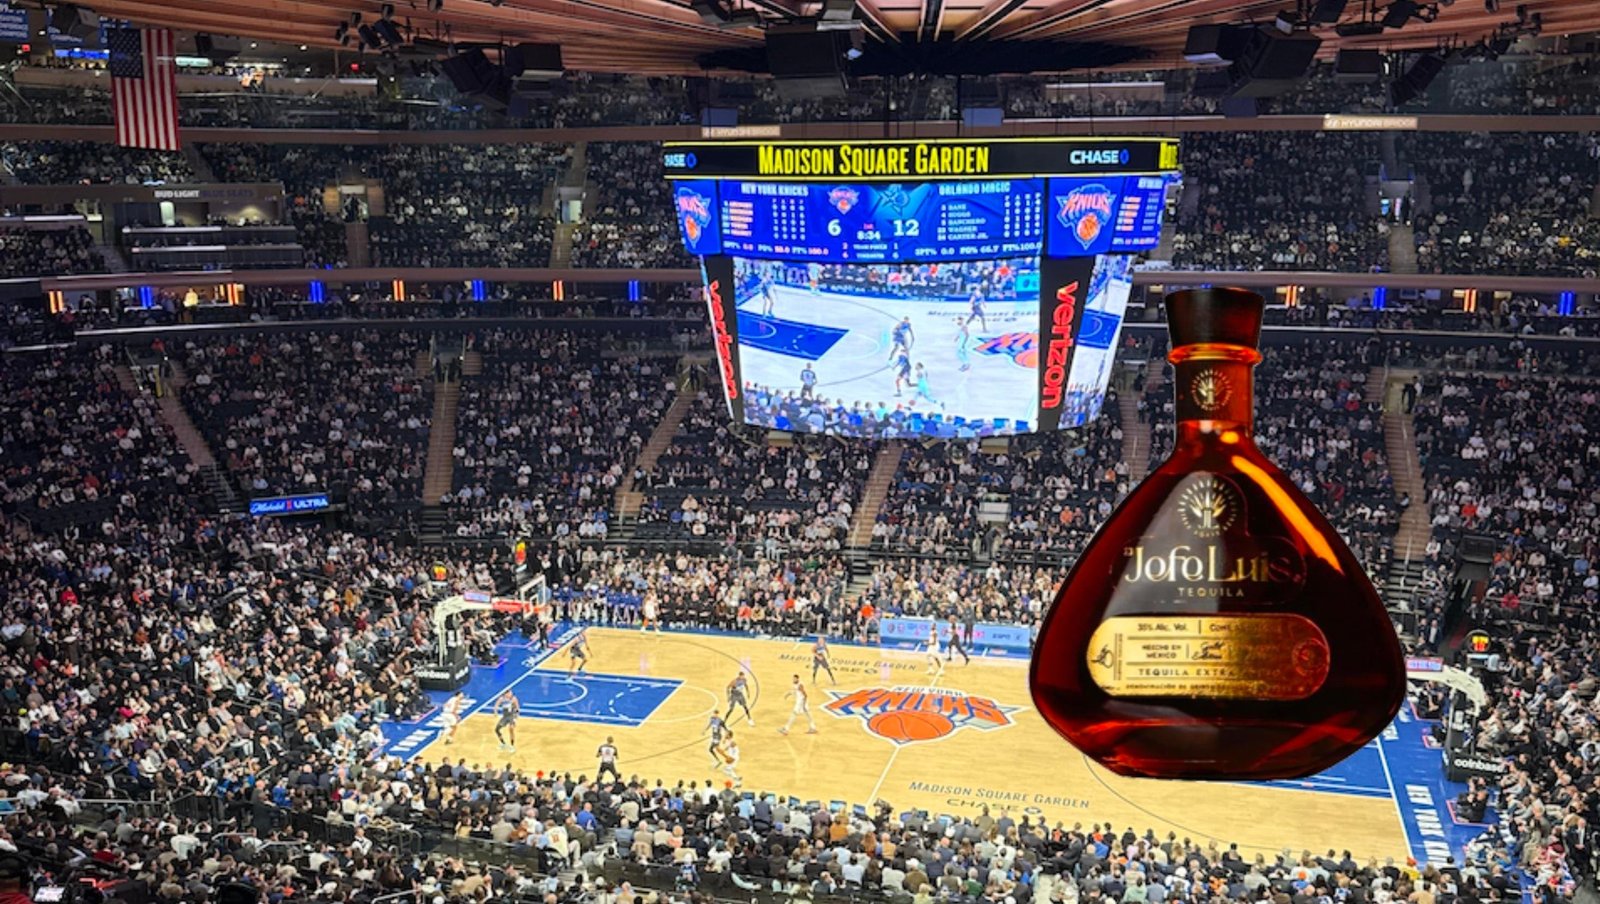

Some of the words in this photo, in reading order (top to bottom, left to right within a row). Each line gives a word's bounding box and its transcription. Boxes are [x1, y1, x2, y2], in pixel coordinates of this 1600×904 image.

[758, 145, 834, 174] MADISON
[839, 144, 909, 177] SQUARE
[915, 144, 989, 174] GARDEN
[1069, 150, 1119, 164] CHASE
[154, 190, 173, 198] BUD
[174, 190, 200, 198] LIGHT
[778, 185, 809, 197] KNICKS
[939, 183, 980, 196] ORLANDO
[981, 181, 1011, 194] MAGIC
[828, 219, 842, 236] 6
[893, 219, 920, 237] 12
[857, 230, 881, 241] 8:34
[710, 280, 737, 399] verizon
[1041, 281, 1079, 409] verizon
[293, 498, 329, 509] ULTRA
[1178, 587, 1245, 597] TEQUILA
[1138, 668, 1189, 676] TEQUILA
[1195, 668, 1235, 676] EXTRA
[825, 689, 1010, 725] KNICKS
[909, 781, 973, 797] MADISON
[975, 787, 1028, 802] SQUARE
[1032, 793, 1091, 809] GARDEN
